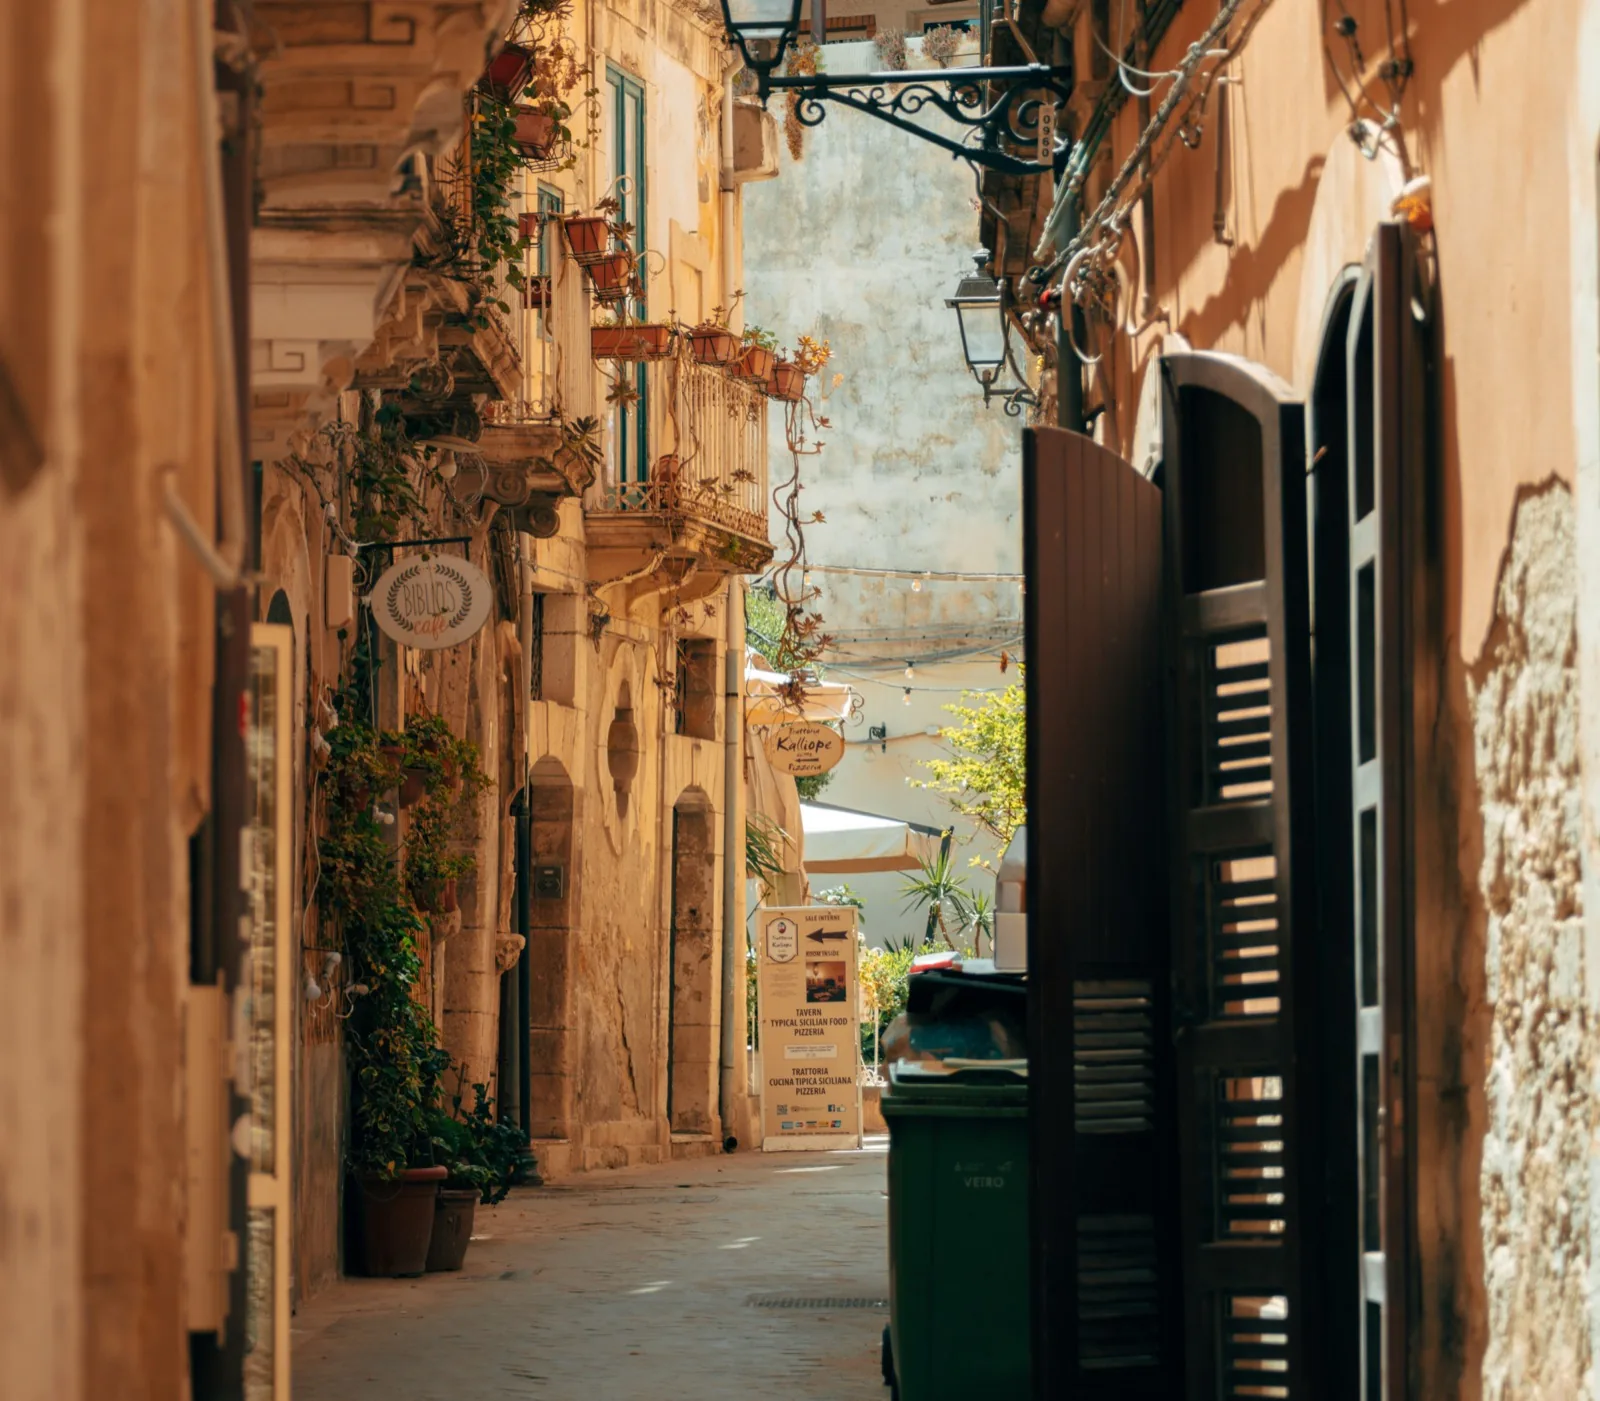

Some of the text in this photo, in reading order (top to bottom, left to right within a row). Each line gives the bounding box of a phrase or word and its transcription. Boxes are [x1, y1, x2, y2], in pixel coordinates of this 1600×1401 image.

[403, 580, 456, 617] BIBLIOS
[788, 727, 821, 735] Trattoria
[776, 736, 833, 753] Kalliope
[788, 763, 822, 771] Pizzeria
[796, 1008, 822, 1016] TAVERN
[771, 1019, 798, 1027] TYPICAL
[799, 1018, 828, 1026] SICILIAN
[794, 1028, 825, 1036] PIZZERIA
[792, 1067, 829, 1075] TRATTORIA
[769, 1078, 795, 1086] CUCINA
[796, 1078, 818, 1086] TIPICA
[796, 1087, 826, 1095] PIZZERIA
